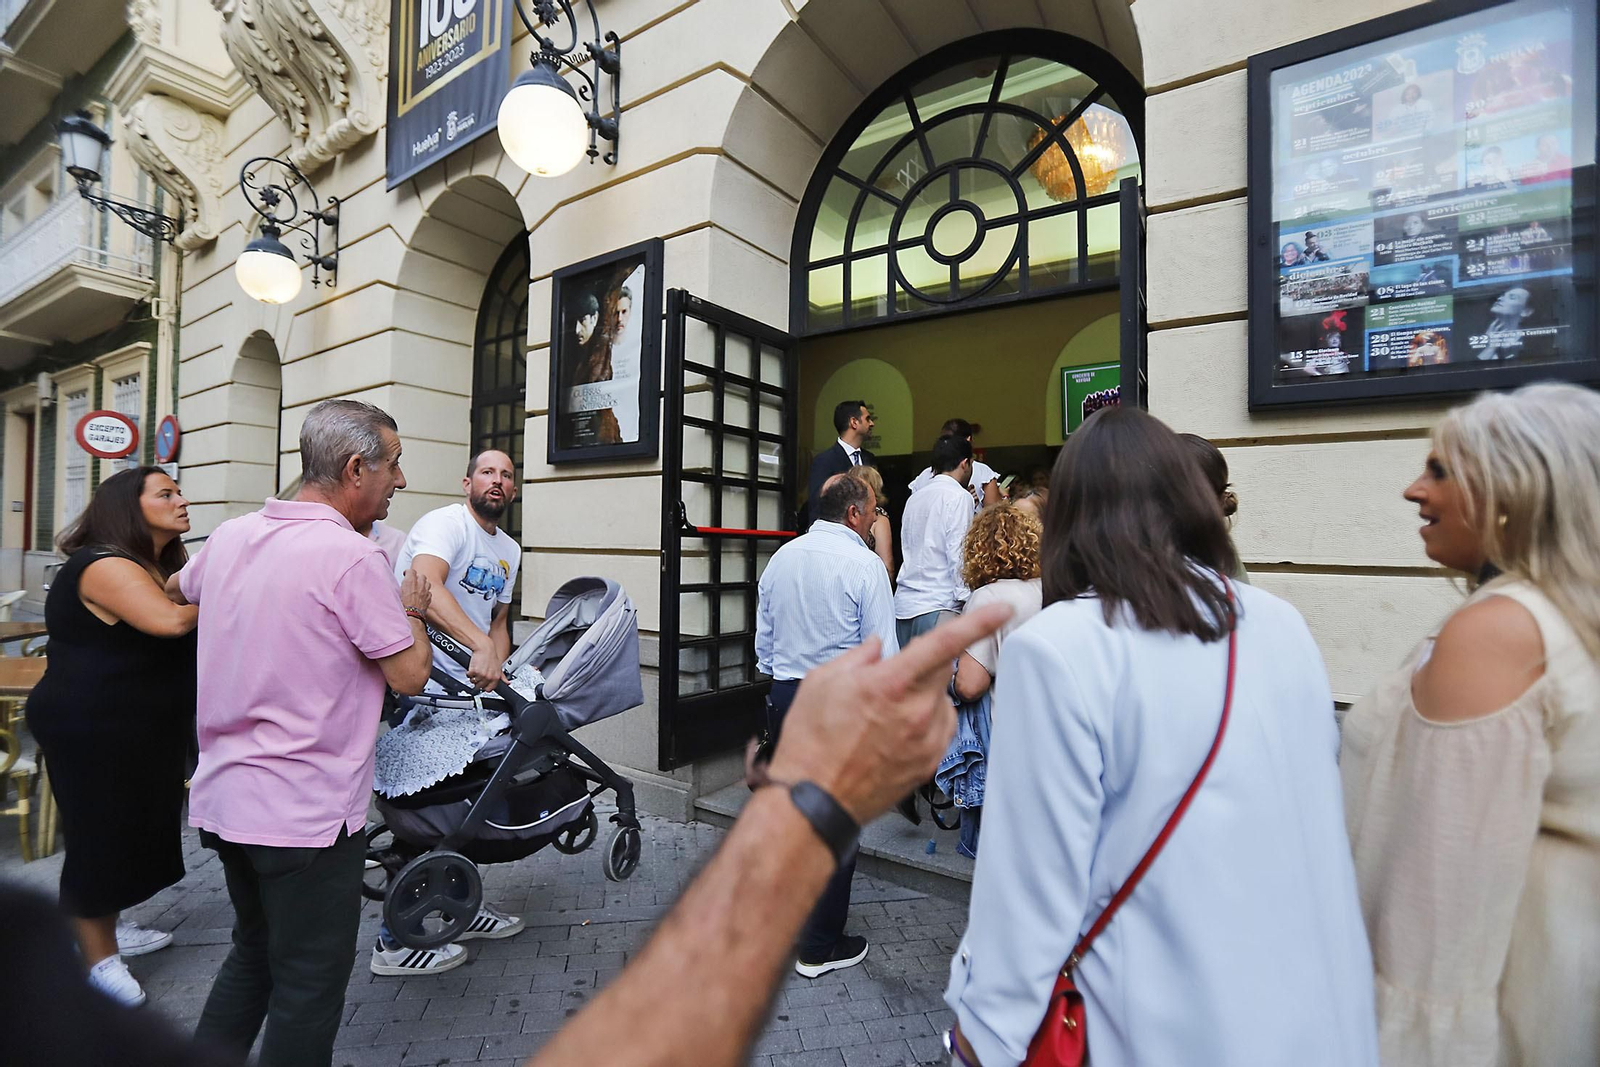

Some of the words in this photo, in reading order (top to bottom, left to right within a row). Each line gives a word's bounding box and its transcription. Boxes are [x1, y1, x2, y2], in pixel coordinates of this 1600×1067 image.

[417, 12, 476, 72] ANIVERSARIO
[425, 43, 465, 79] 1923-2023
[1294, 91, 1356, 113] septiembre
[1343, 147, 1388, 160] octubre
[1427, 198, 1498, 216] noviembre
[1376, 241, 1393, 252] 04
[1466, 238, 1485, 250] 24
[1289, 266, 1346, 281] diciembre
[1466, 263, 1486, 274] 25
[1376, 286, 1394, 296] 08
[1370, 307, 1385, 317] 21
[1370, 333, 1389, 344] 29
[1469, 334, 1489, 345] 22
[1289, 350, 1304, 359] 15
[1370, 346, 1390, 357] 30
[89, 423, 125, 434] EXCEPTO
[88, 433, 125, 444] GARAJES
